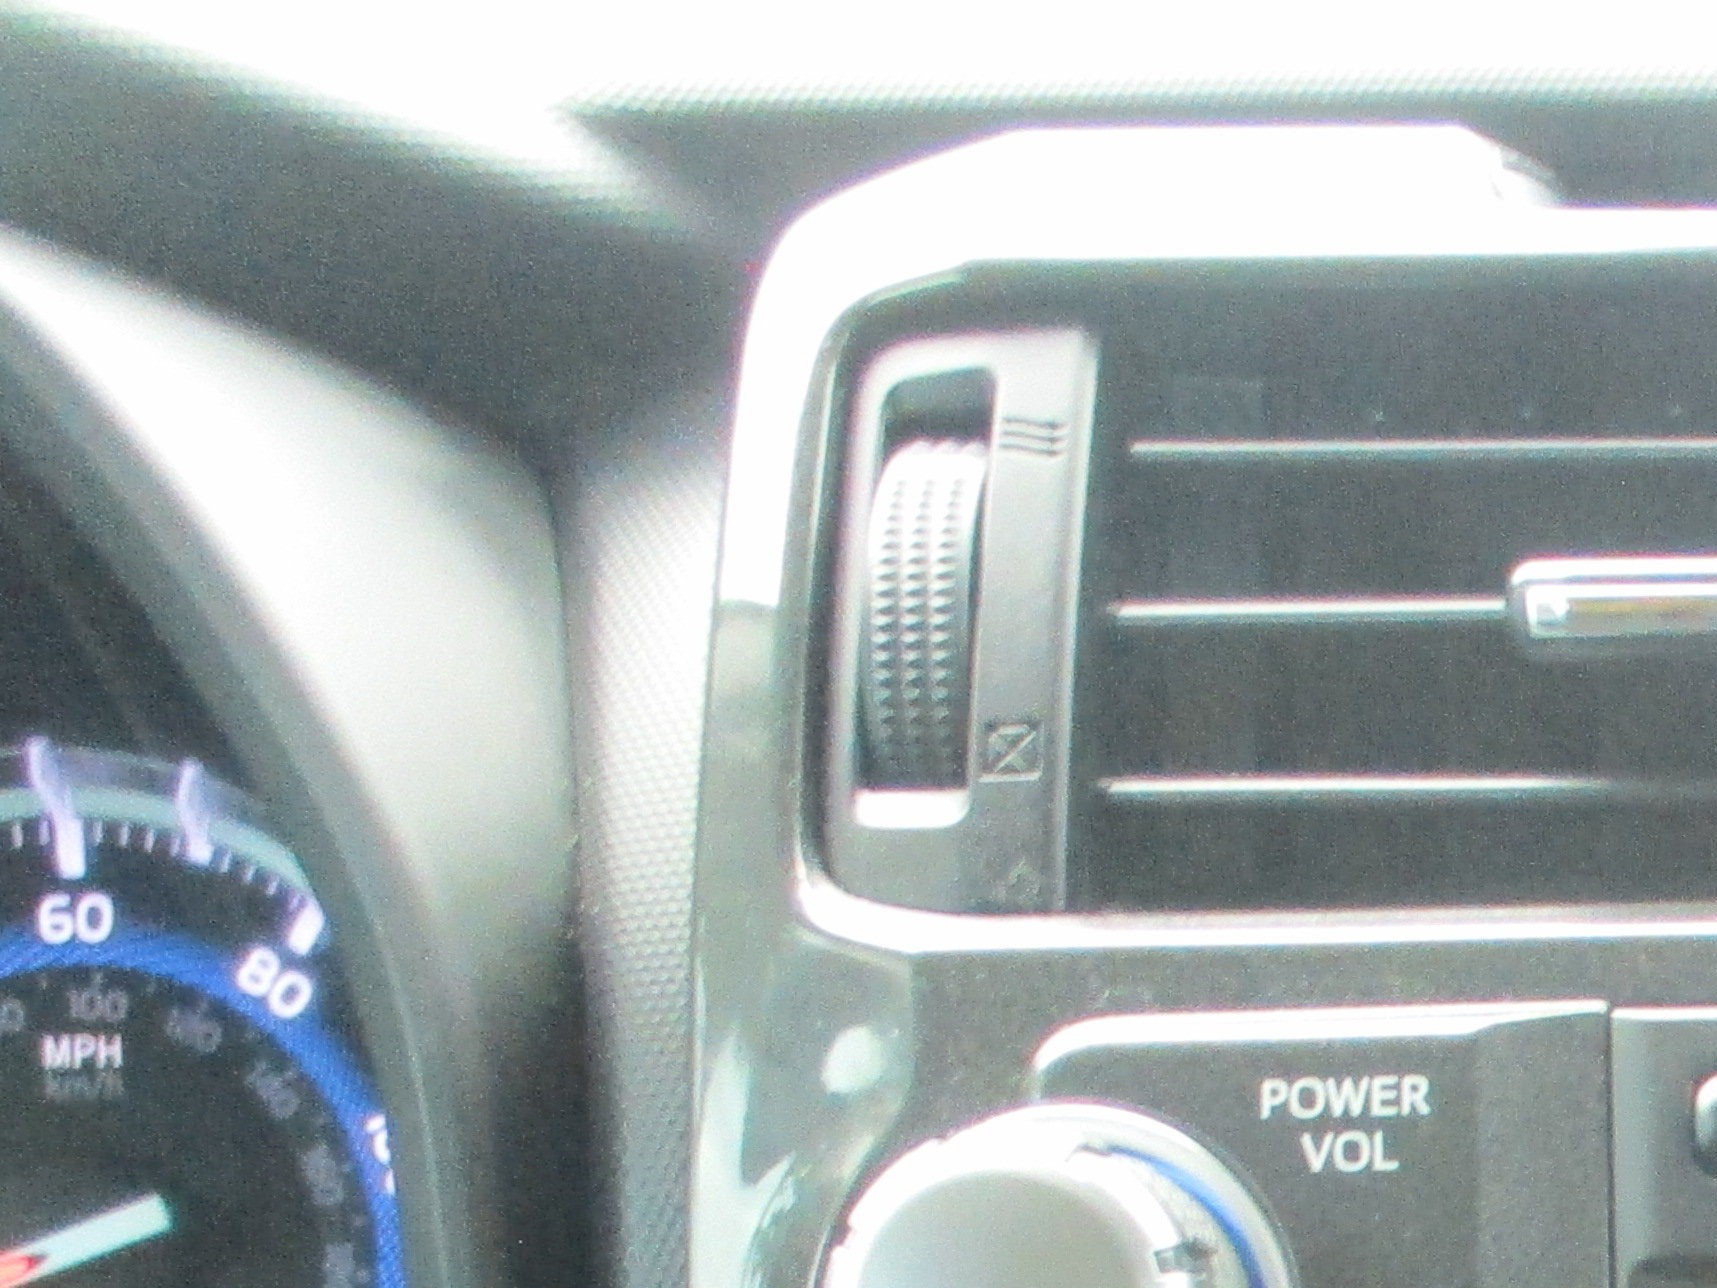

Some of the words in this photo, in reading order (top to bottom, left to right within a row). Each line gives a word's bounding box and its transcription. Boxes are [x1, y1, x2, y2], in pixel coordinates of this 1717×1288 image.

[37, 893, 113, 944] 60
[236, 946, 312, 1018] 80
[41, 1032, 123, 1070] MPH
[1259, 1075, 1431, 1122] POWER
[1300, 1131, 1399, 1175] VOL
